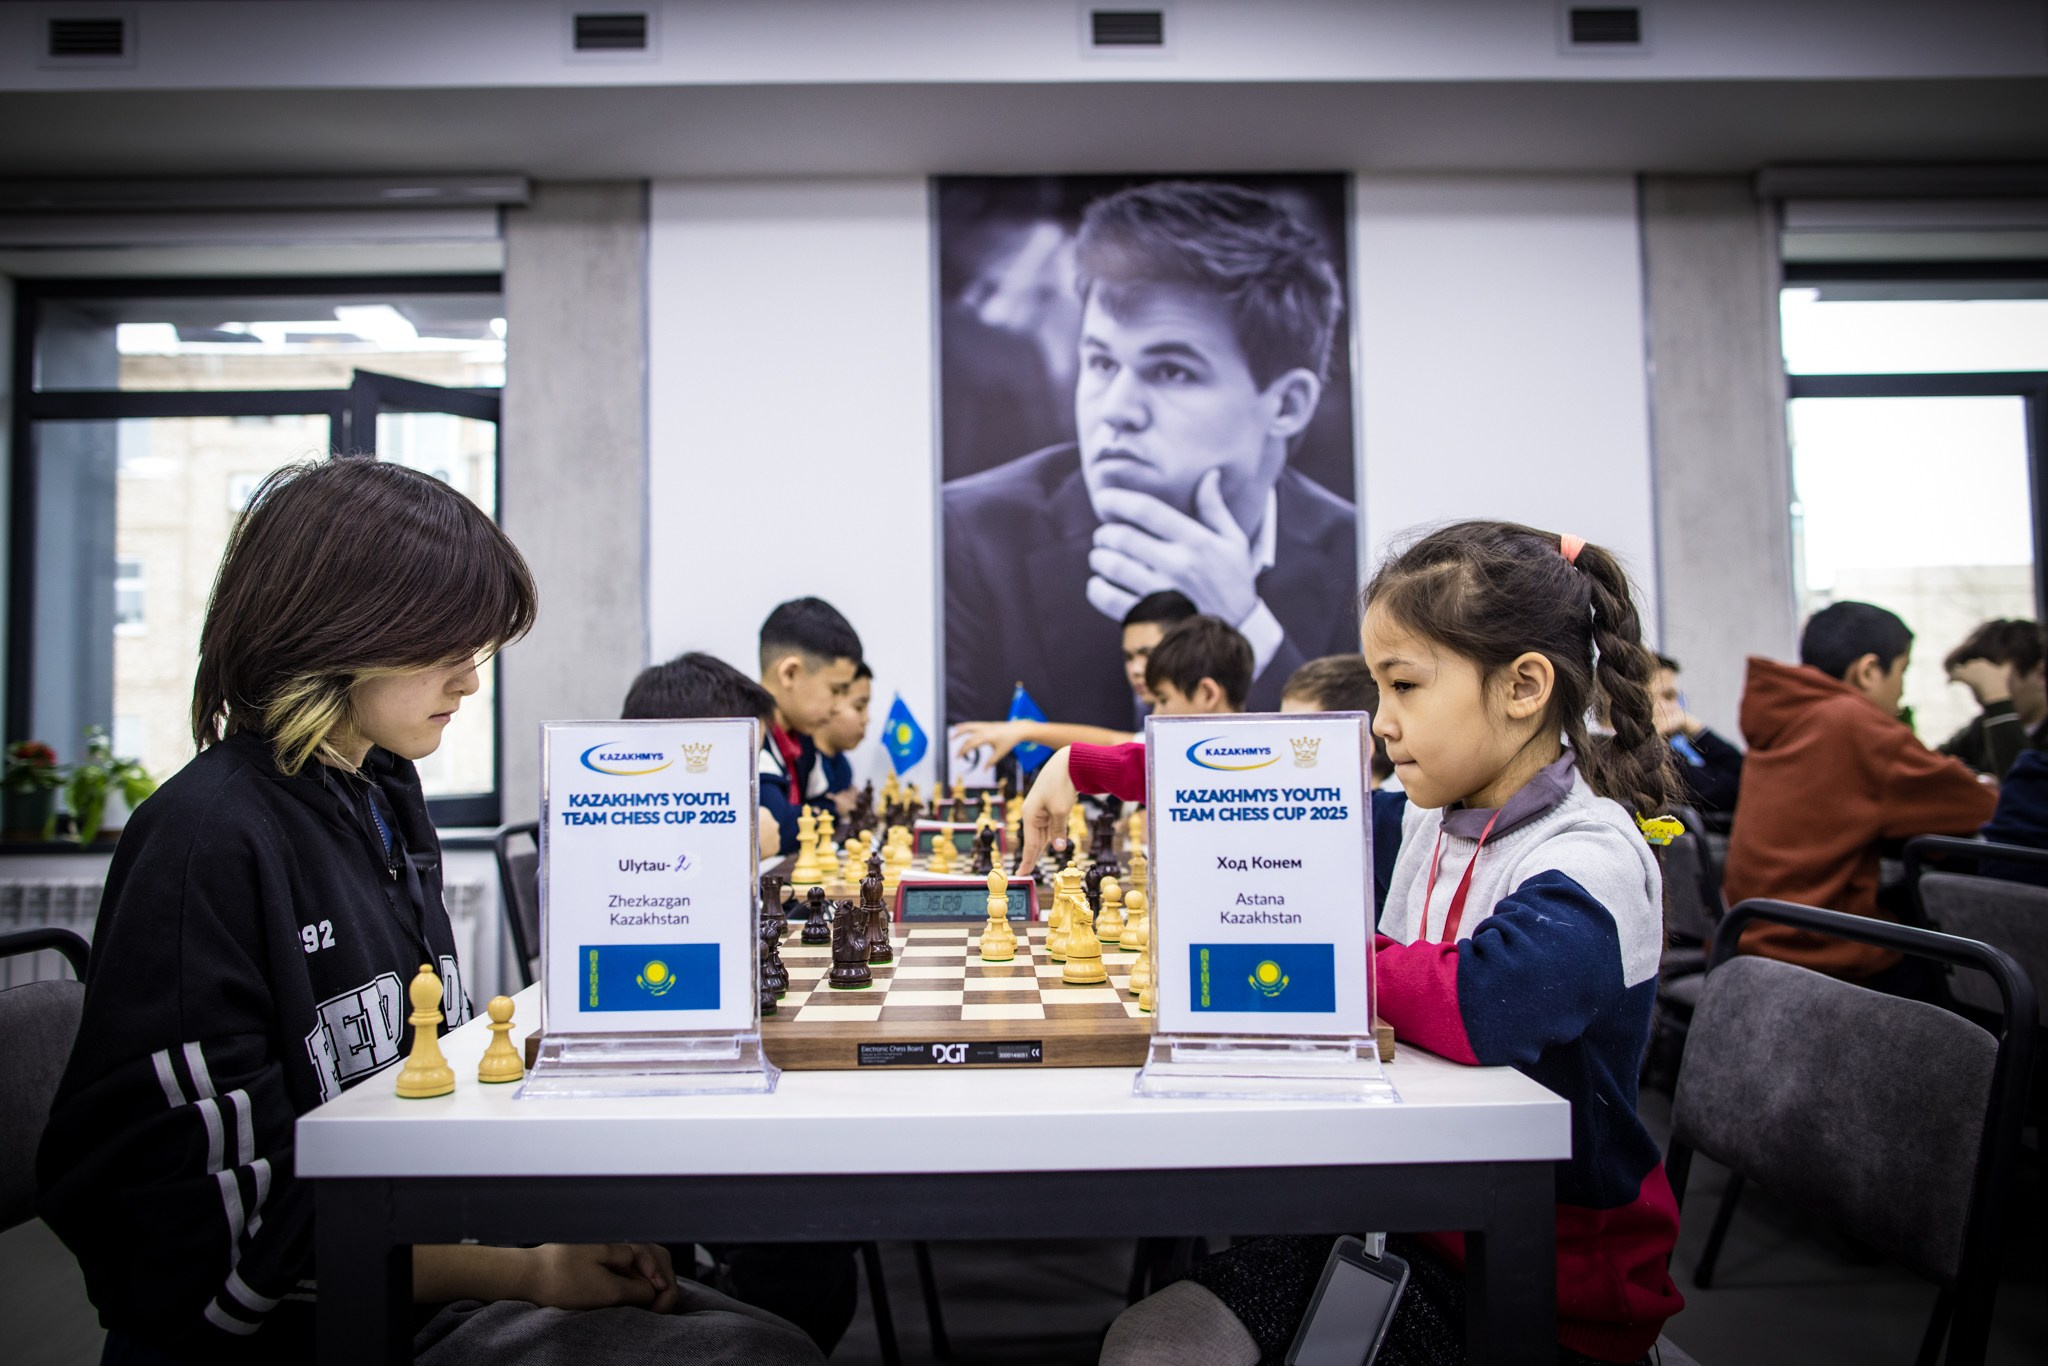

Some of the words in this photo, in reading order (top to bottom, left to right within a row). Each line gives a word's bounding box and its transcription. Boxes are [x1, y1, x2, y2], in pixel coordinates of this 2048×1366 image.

[599, 752, 664, 761] KAZAKHMYS
[1205, 747, 1271, 756] KAZAKHMYS
[569, 793, 669, 807] KAZAKHMYS
[672, 792, 730, 806] YOUTH
[1176, 789, 1278, 803] KAZAKHMYS
[1282, 788, 1341, 801] YOUTH
[562, 812, 607, 825] TEAM
[611, 811, 660, 825] CHESS
[664, 811, 697, 824] CUP
[700, 810, 736, 824] 2025
[1169, 808, 1215, 822] TEAM
[1219, 807, 1269, 821] CHESS
[1273, 807, 1306, 821] CUP
[1310, 806, 1348, 820] 2025
[1217, 856, 1248, 871] Ход
[1251, 856, 1302, 869] Конем
[608, 894, 691, 910] Zhezkazgan
[1235, 892, 1285, 905] Astana
[610, 912, 690, 926] Kazakhstan
[1220, 911, 1302, 924] Kazakhstan
[861, 1045, 889, 1053] Electronic
[932, 1043, 969, 1064] DGT
